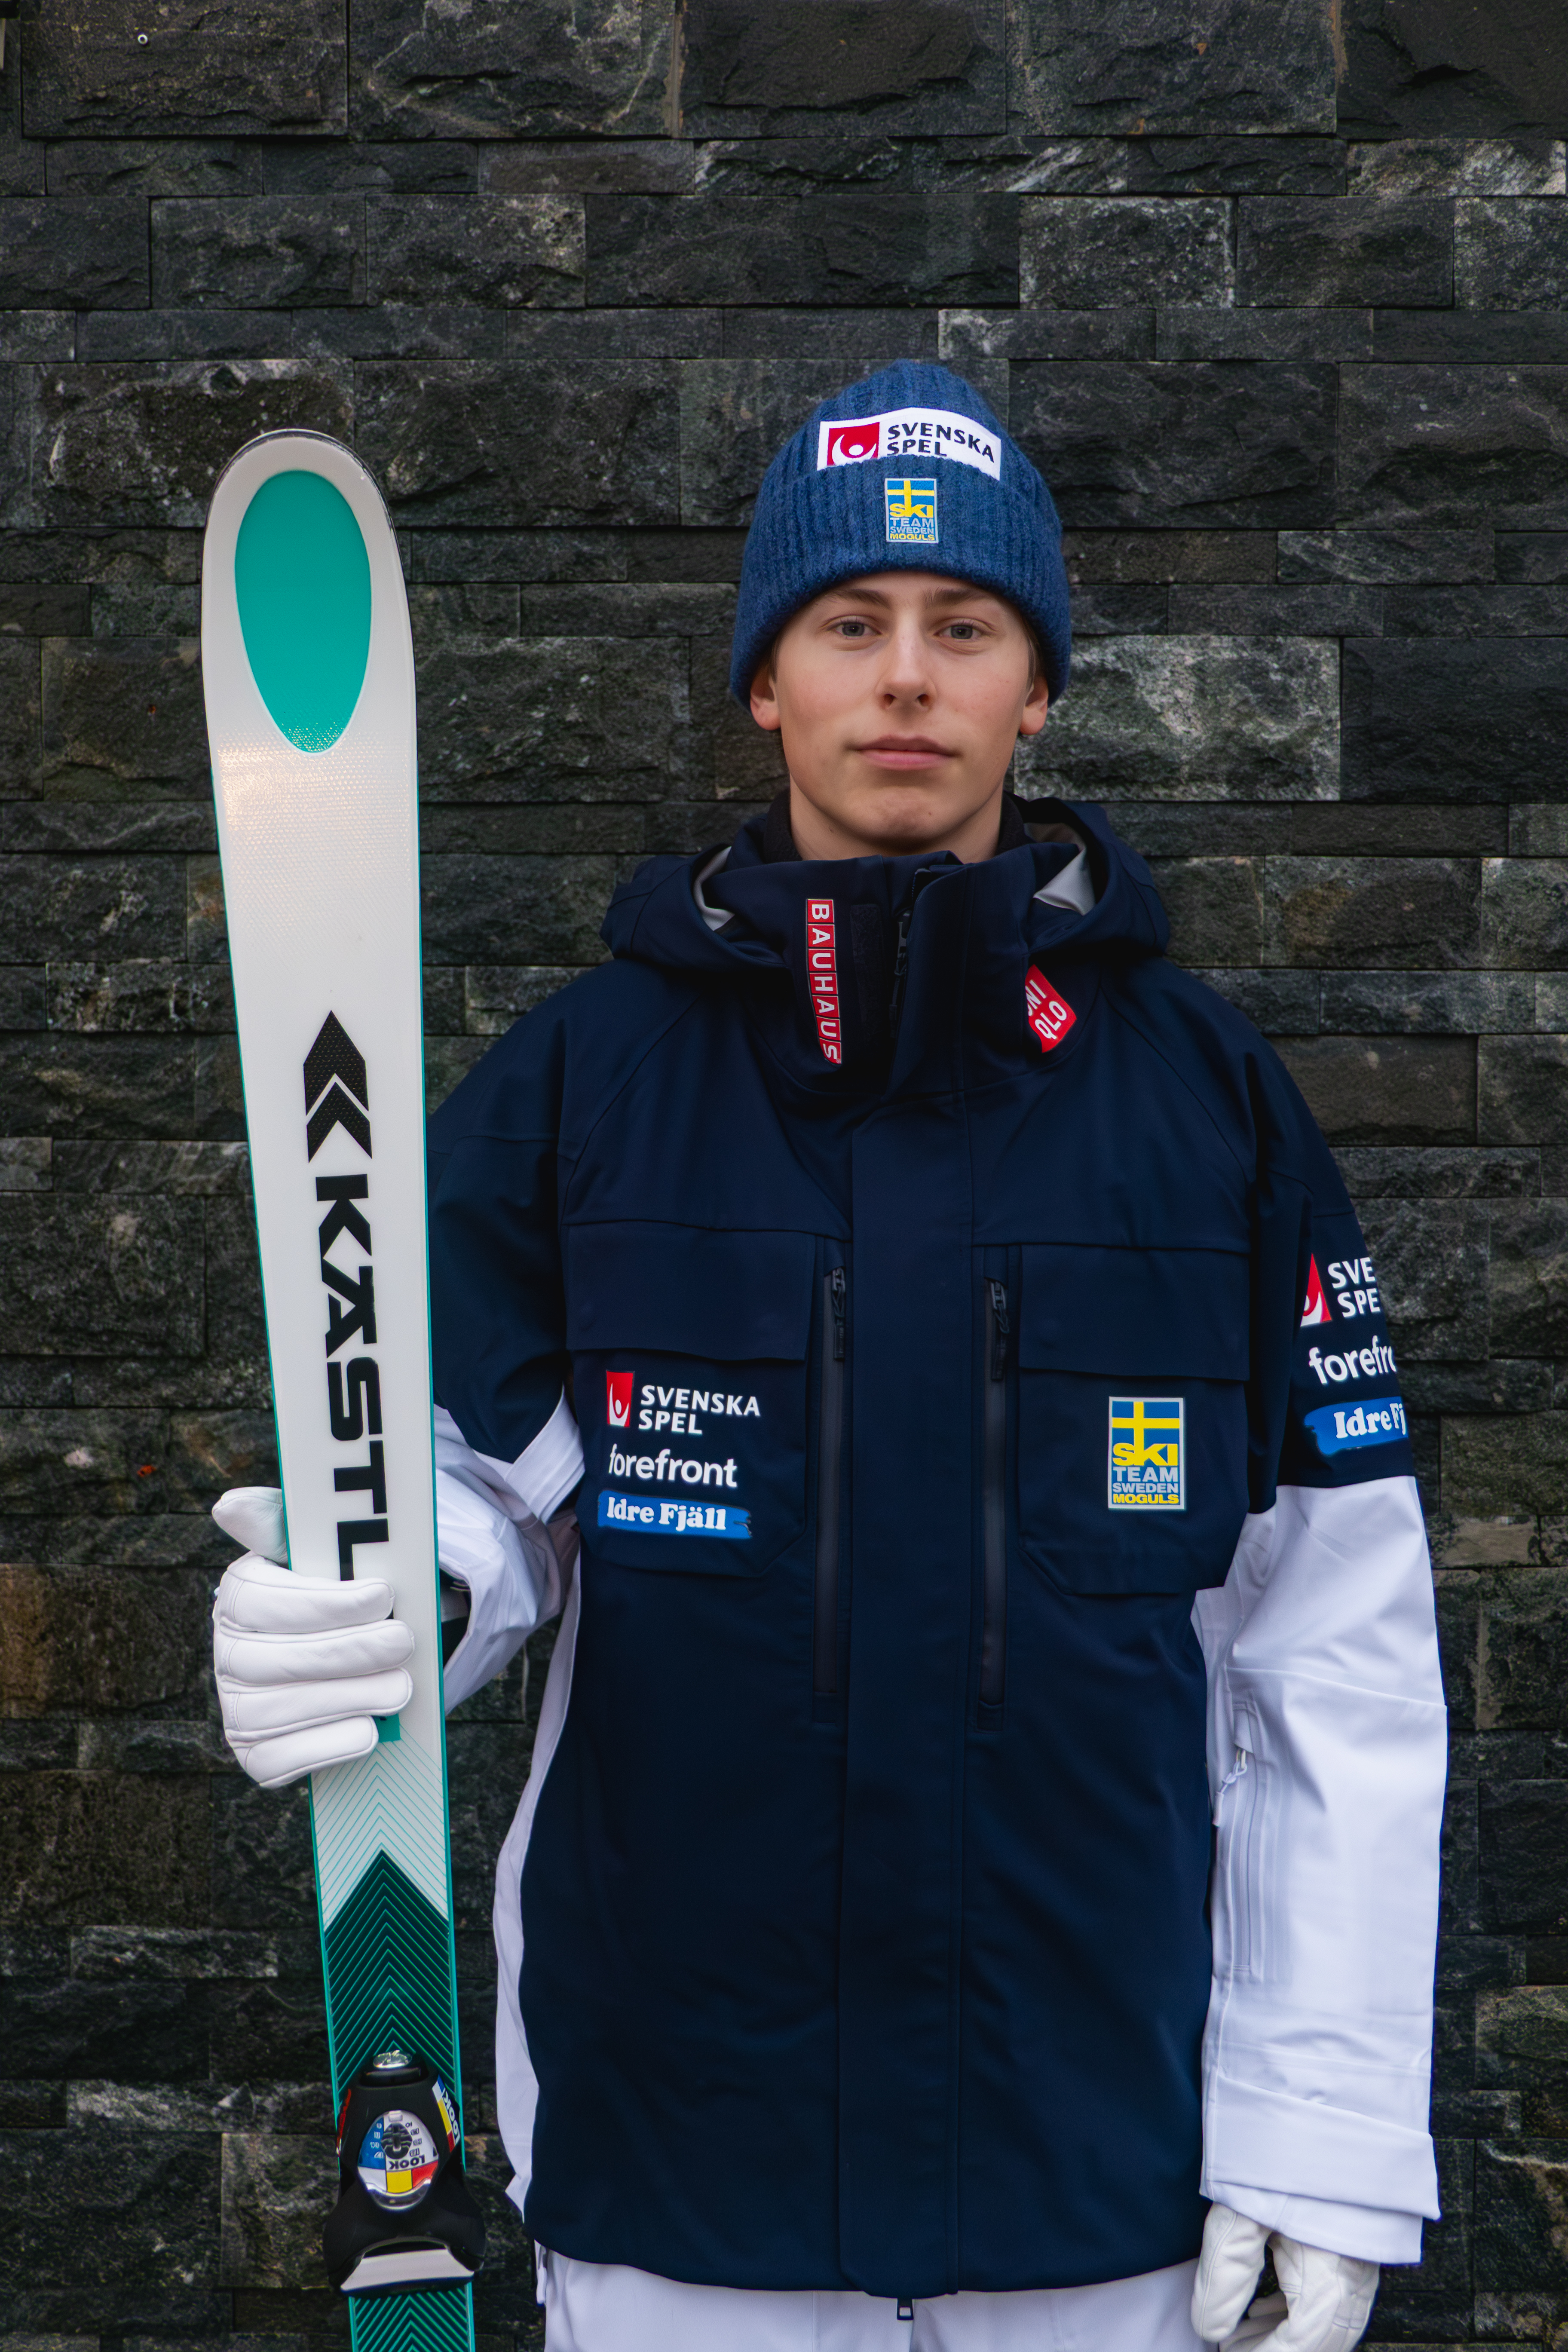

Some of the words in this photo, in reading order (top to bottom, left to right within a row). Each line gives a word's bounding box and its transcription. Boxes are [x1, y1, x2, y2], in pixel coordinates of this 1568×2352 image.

[887, 439, 947, 456] SPEL
[888, 423, 995, 463] SVENSKA
[889, 503, 934, 518] SKI
[890, 518, 934, 527] TEAM
[812, 904, 837, 1060] BAUHAUS
[1035, 1001, 1067, 1040] QLO
[1328, 1257, 1375, 1289] SVE
[1337, 1288, 1381, 1317] SPE
[640, 1385, 760, 1417] SVENSKA
[638, 1409, 702, 1435] SPEL
[1333, 1407, 1392, 1439] Idre
[609, 1443, 738, 1488] forefront
[1112, 1442, 1178, 1467] SKI
[1112, 1467, 1179, 1482] TEAM
[1112, 1482, 1179, 1493] SWEDEN
[1113, 1494, 1179, 1504] MOGULS
[606, 1497, 655, 1523] Idre
[658, 1503, 726, 1531] Fjäll
[442, 2089, 460, 2143] LOOK
[389, 2154, 425, 2171] LOOK
